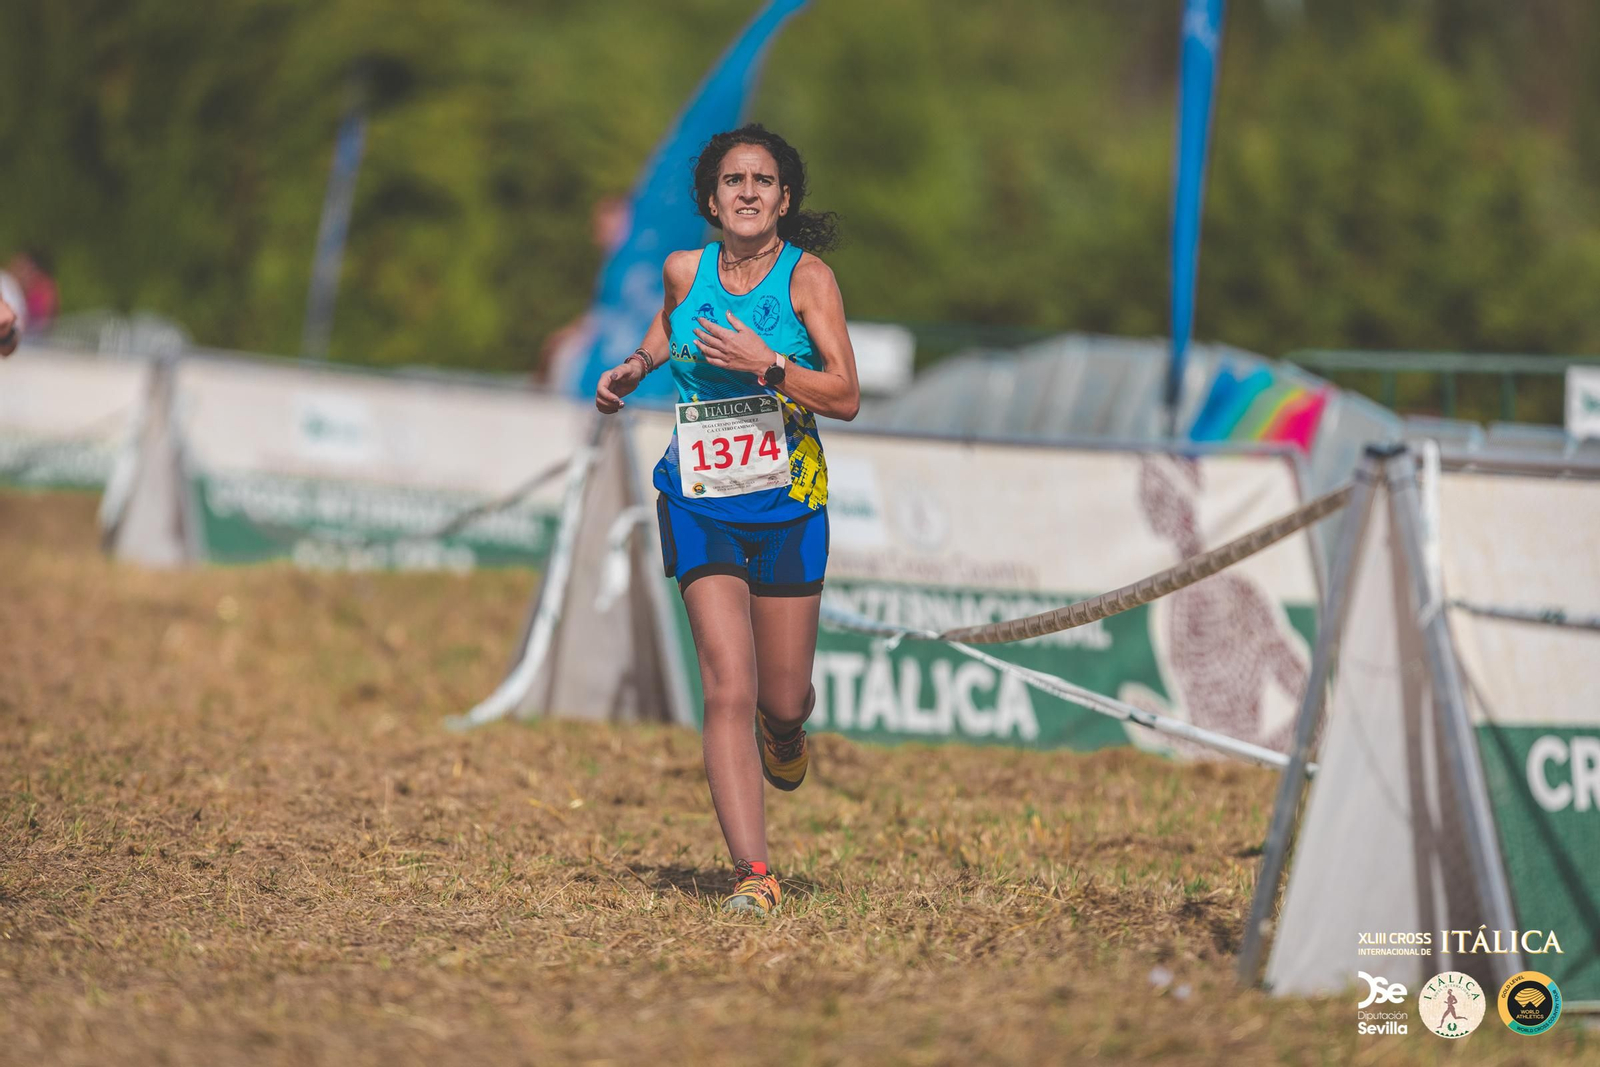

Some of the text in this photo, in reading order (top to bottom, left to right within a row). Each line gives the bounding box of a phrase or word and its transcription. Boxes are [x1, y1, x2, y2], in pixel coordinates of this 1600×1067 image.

[704, 402, 752, 418] ITÁLICA
[691, 430, 781, 472] 1374
[811, 638, 1040, 740] ITÁLICA
[1526, 734, 1600, 812] CR
